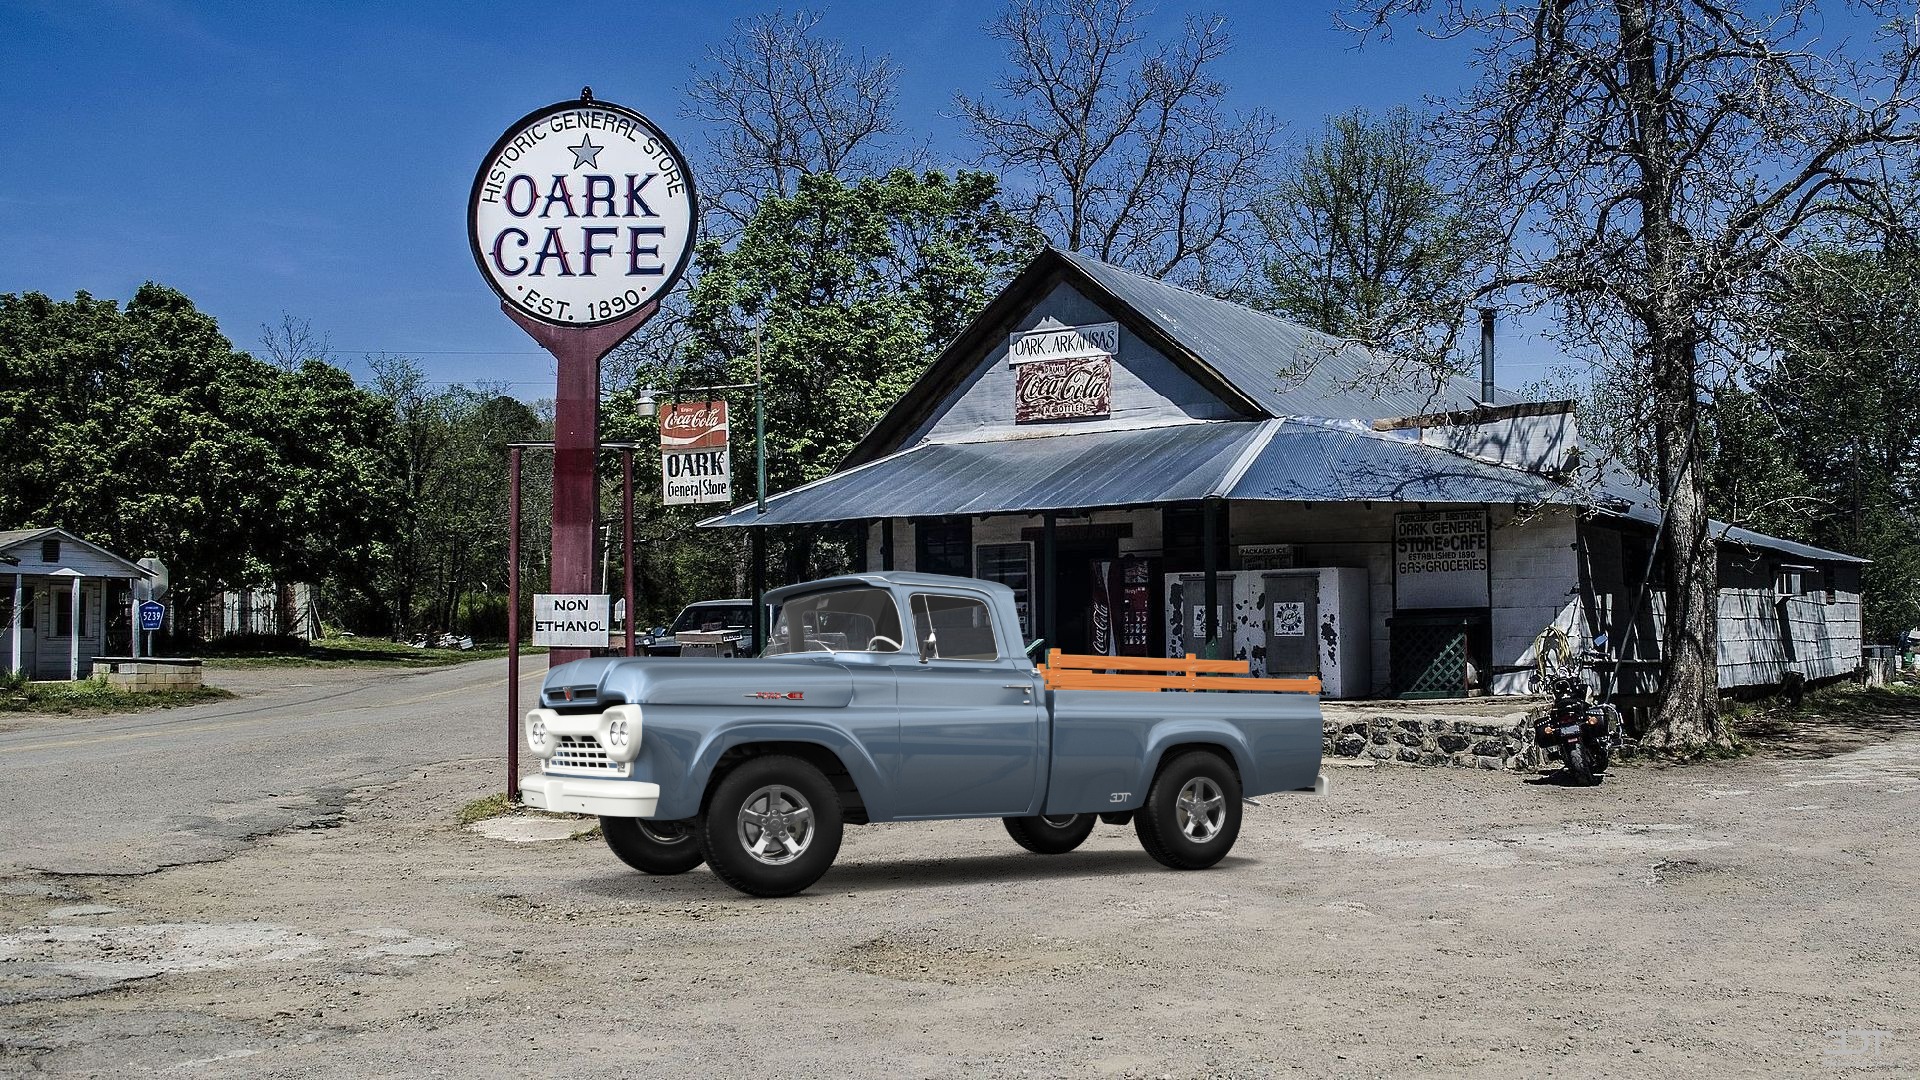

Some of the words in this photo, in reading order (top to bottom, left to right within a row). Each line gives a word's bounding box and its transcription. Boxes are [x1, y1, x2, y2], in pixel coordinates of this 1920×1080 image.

[482, 125, 548, 204] HISTORIC
[550, 111, 639, 143] GENERAL
[642, 137, 685, 198] STORE
[502, 173, 660, 218] OARK
[489, 226, 666, 277] CAFE
[522, 289, 574, 321] EST.
[587, 289, 640, 321] 1890
[1051, 330, 1115, 353] ARKANSAS
[667, 452, 725, 478] OARK
[667, 480, 702, 498] General
[702, 480, 727, 496] Store
[1399, 523, 1428, 536] OARK
[1432, 521, 1485, 534] GENERAL
[1398, 537, 1443, 553] STORE
[1450, 534, 1486, 550] CAFE
[1408, 552, 1456, 561] ESTABLISHED
[1458, 551, 1476, 559] 1890
[1426, 559, 1486, 573] GROCERIES
[554, 600, 589, 611] NON
[143, 612, 161, 620] 5239
[535, 618, 605, 632] ETHANOL
